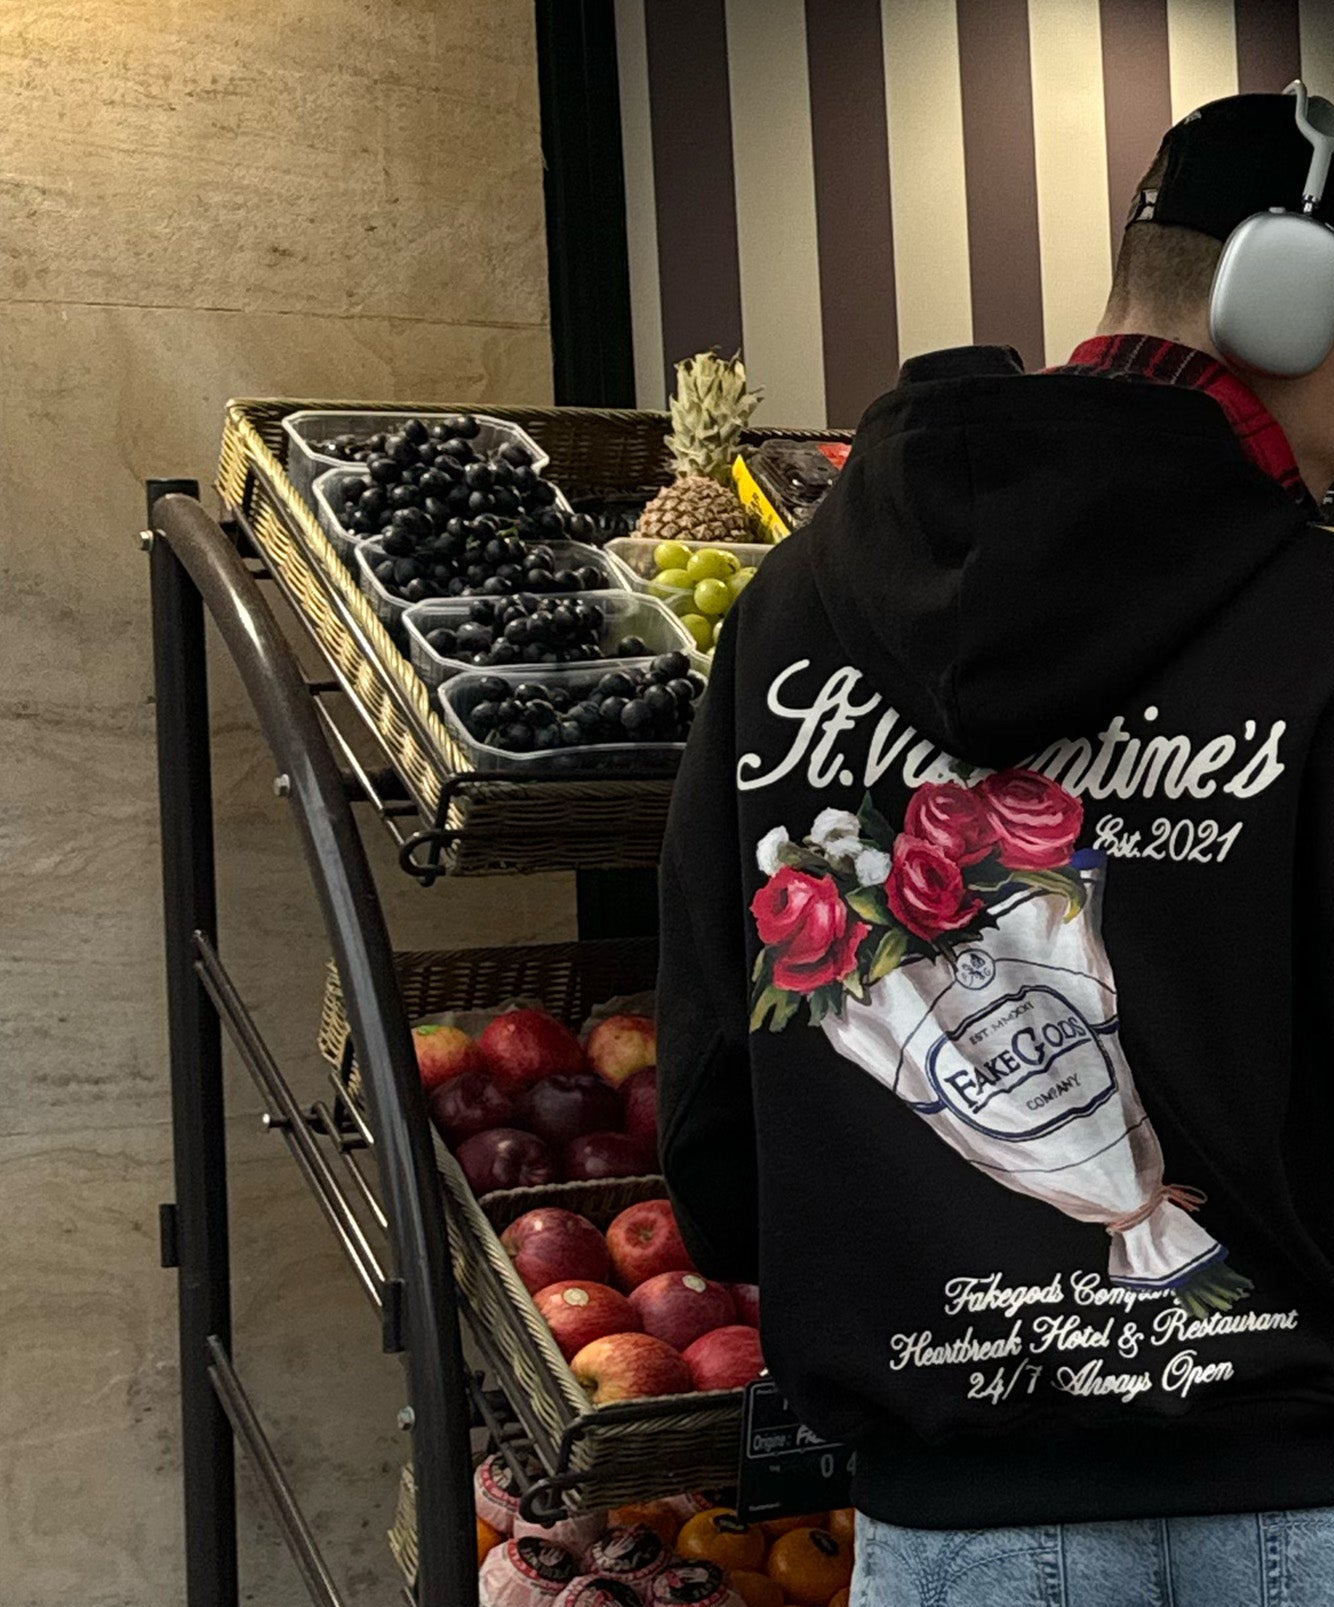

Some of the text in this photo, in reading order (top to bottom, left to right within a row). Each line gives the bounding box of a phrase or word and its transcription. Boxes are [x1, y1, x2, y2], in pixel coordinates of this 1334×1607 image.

[1026, 1073, 1081, 1111] COMPANY
[945, 1271, 1065, 1317] Fakegods
[889, 1308, 1299, 1371] Heartbreak Hotel & Restaurant
[967, 1349, 1235, 1405] 24/7 Always Open
